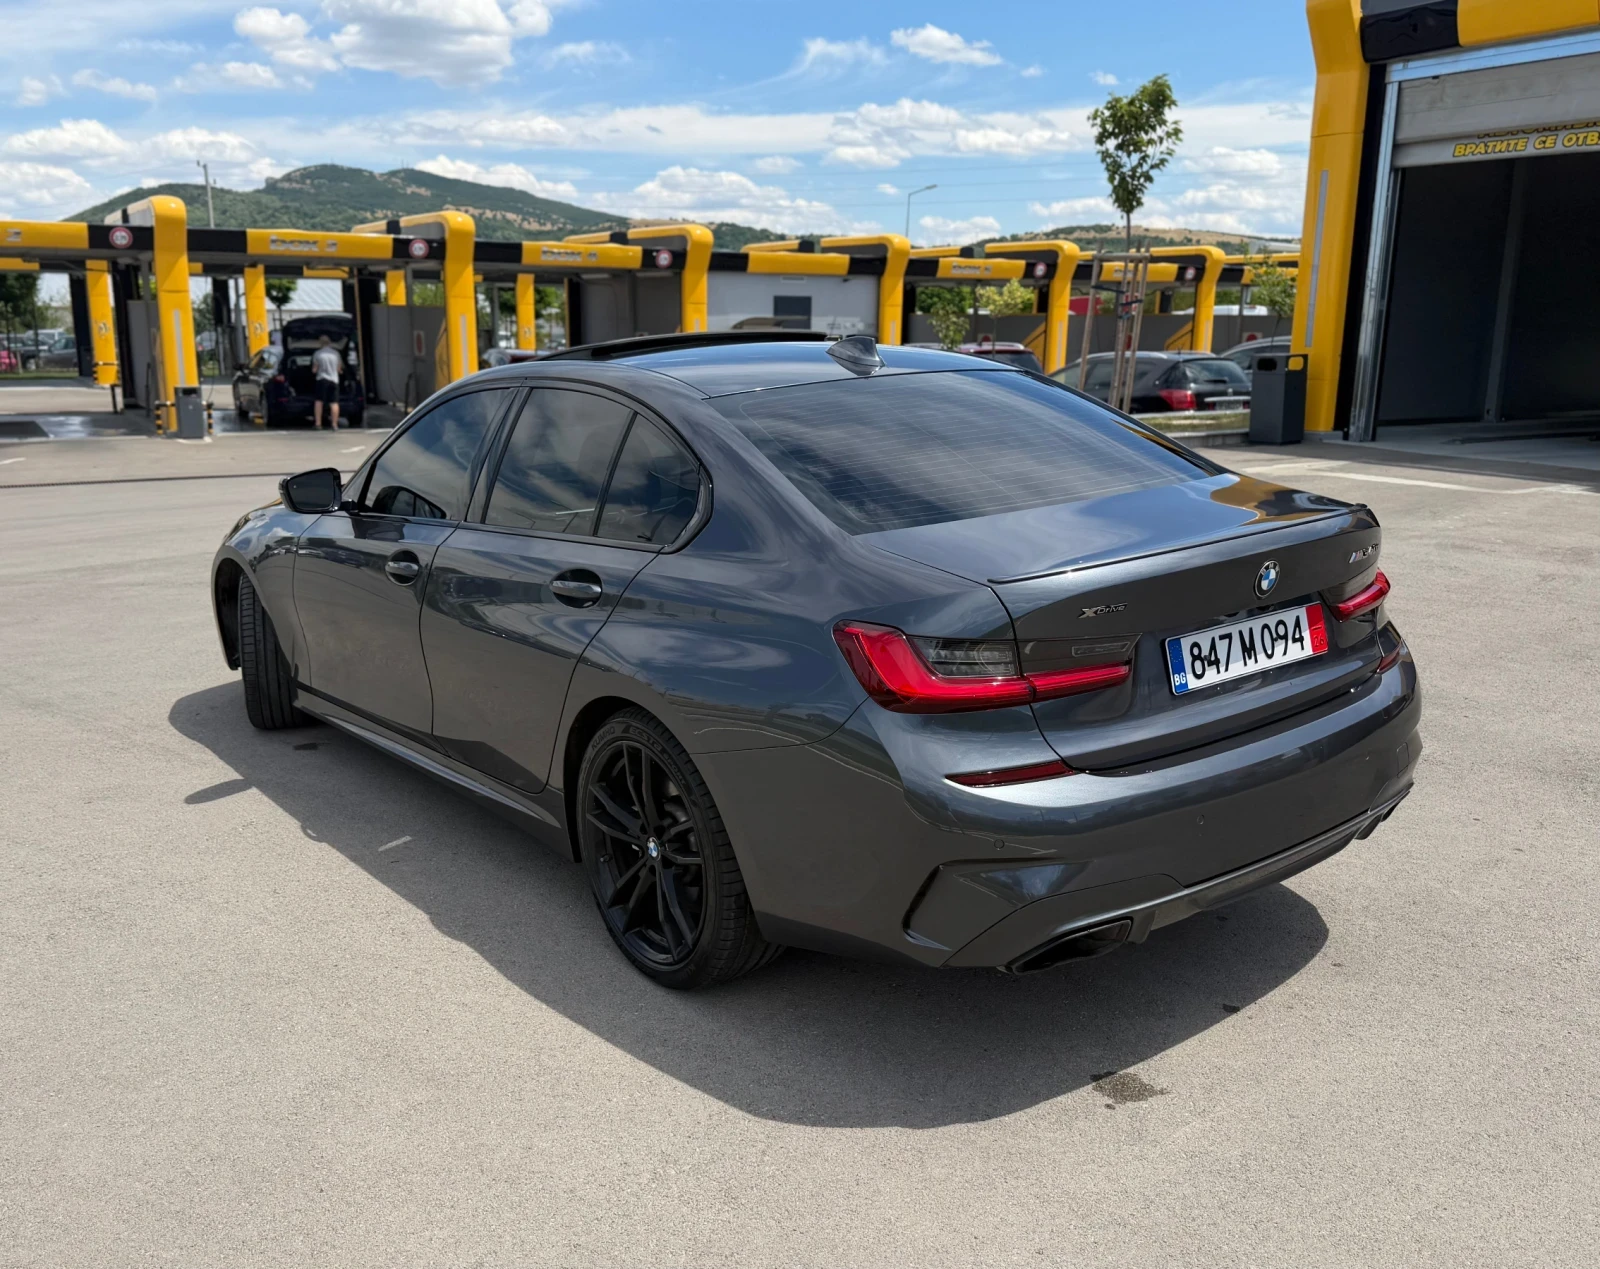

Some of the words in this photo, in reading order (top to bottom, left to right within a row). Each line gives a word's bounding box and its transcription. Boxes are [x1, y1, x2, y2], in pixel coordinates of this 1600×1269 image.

[1453, 137, 1529, 157] ВРАТИТЕ
[1533, 134, 1557, 149] СЕ
[1562, 130, 1600, 148] ОТВ
[1173, 673, 1187, 686] BG
[591, 726, 616, 751] KUMHO
